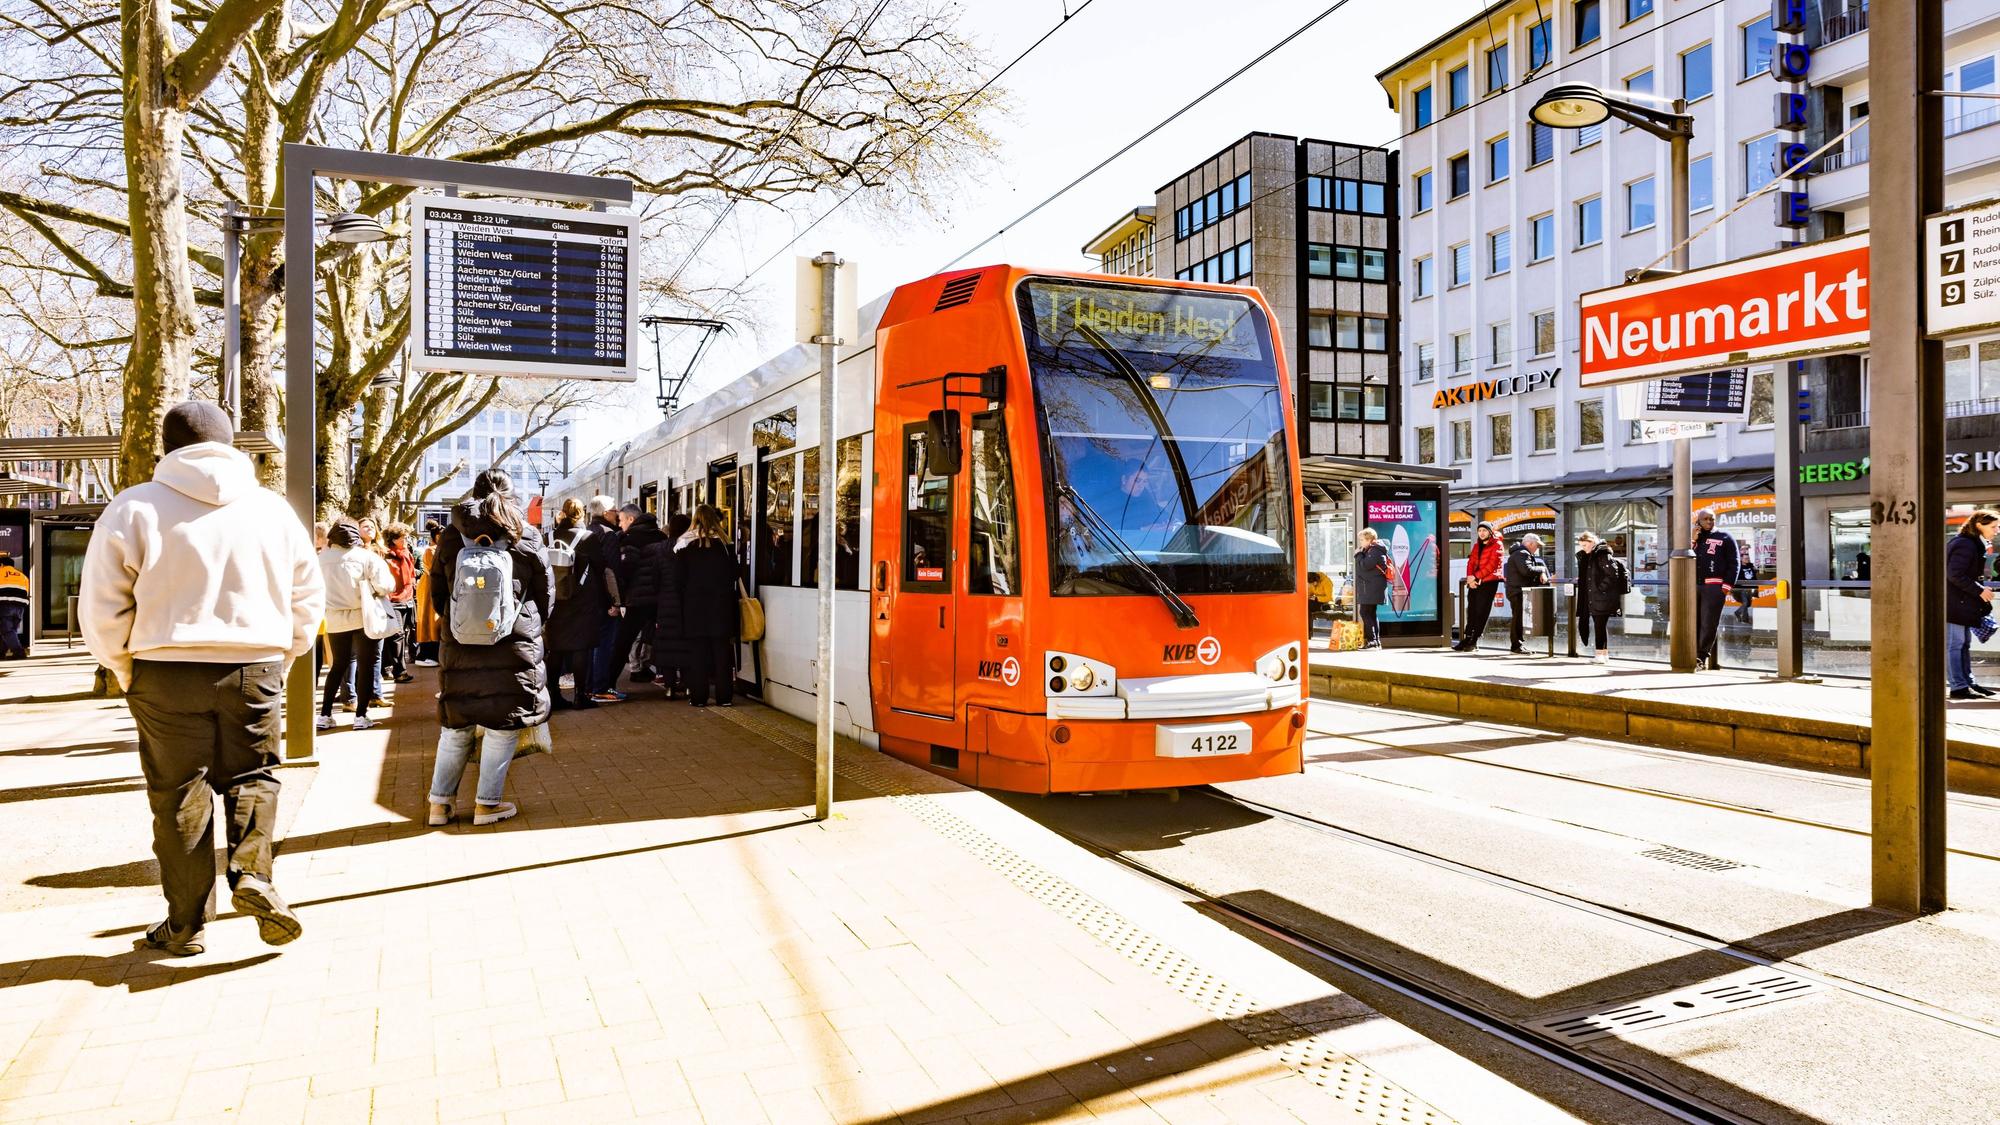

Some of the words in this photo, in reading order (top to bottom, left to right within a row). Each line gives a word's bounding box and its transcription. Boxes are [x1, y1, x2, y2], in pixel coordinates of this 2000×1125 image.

[430, 211, 462, 220] 03.04.23
[472, 215, 493, 223] 13:22
[458, 223, 490, 232] Weiden
[552, 222, 570, 230] Gleis
[458, 232, 501, 242] Benzelrath
[1946, 224, 1956, 241] 1
[457, 240, 474, 248] Sülz
[458, 249, 490, 258] Weiden
[457, 257, 474, 265] Sülz
[1946, 254, 1960, 272] 7
[457, 266, 496, 276] Aachener
[499, 269, 541, 279] Str./Gürtel
[458, 274, 490, 283] Weiden
[458, 282, 501, 293] Benzelrath
[458, 291, 490, 300] Weiden
[1946, 284, 1960, 303] 9
[1973, 289, 1997, 300] Sülz.
[457, 300, 496, 310] Aachener
[499, 303, 541, 313] Str./Gürtel
[457, 308, 474, 316] Sülz
[458, 316, 490, 325] Weiden
[1050, 292, 1058, 334] 1
[1074, 296, 1165, 336] Weiden
[1174, 304, 1235, 341] West
[1584, 268, 1867, 364] Neumarkt
[458, 325, 501, 335] Benzelrath
[457, 333, 474, 341] Sülz
[458, 342, 490, 351] Weiden
[1432, 368, 1562, 409] AKTIVCOPY
[1871, 500, 1916, 525] 343
[1502, 522, 1536, 534] STUDENTEN
[1163, 644, 1197, 661] KVB
[978, 660, 1002, 678] KVB
[1191, 735, 1237, 752] 4122
